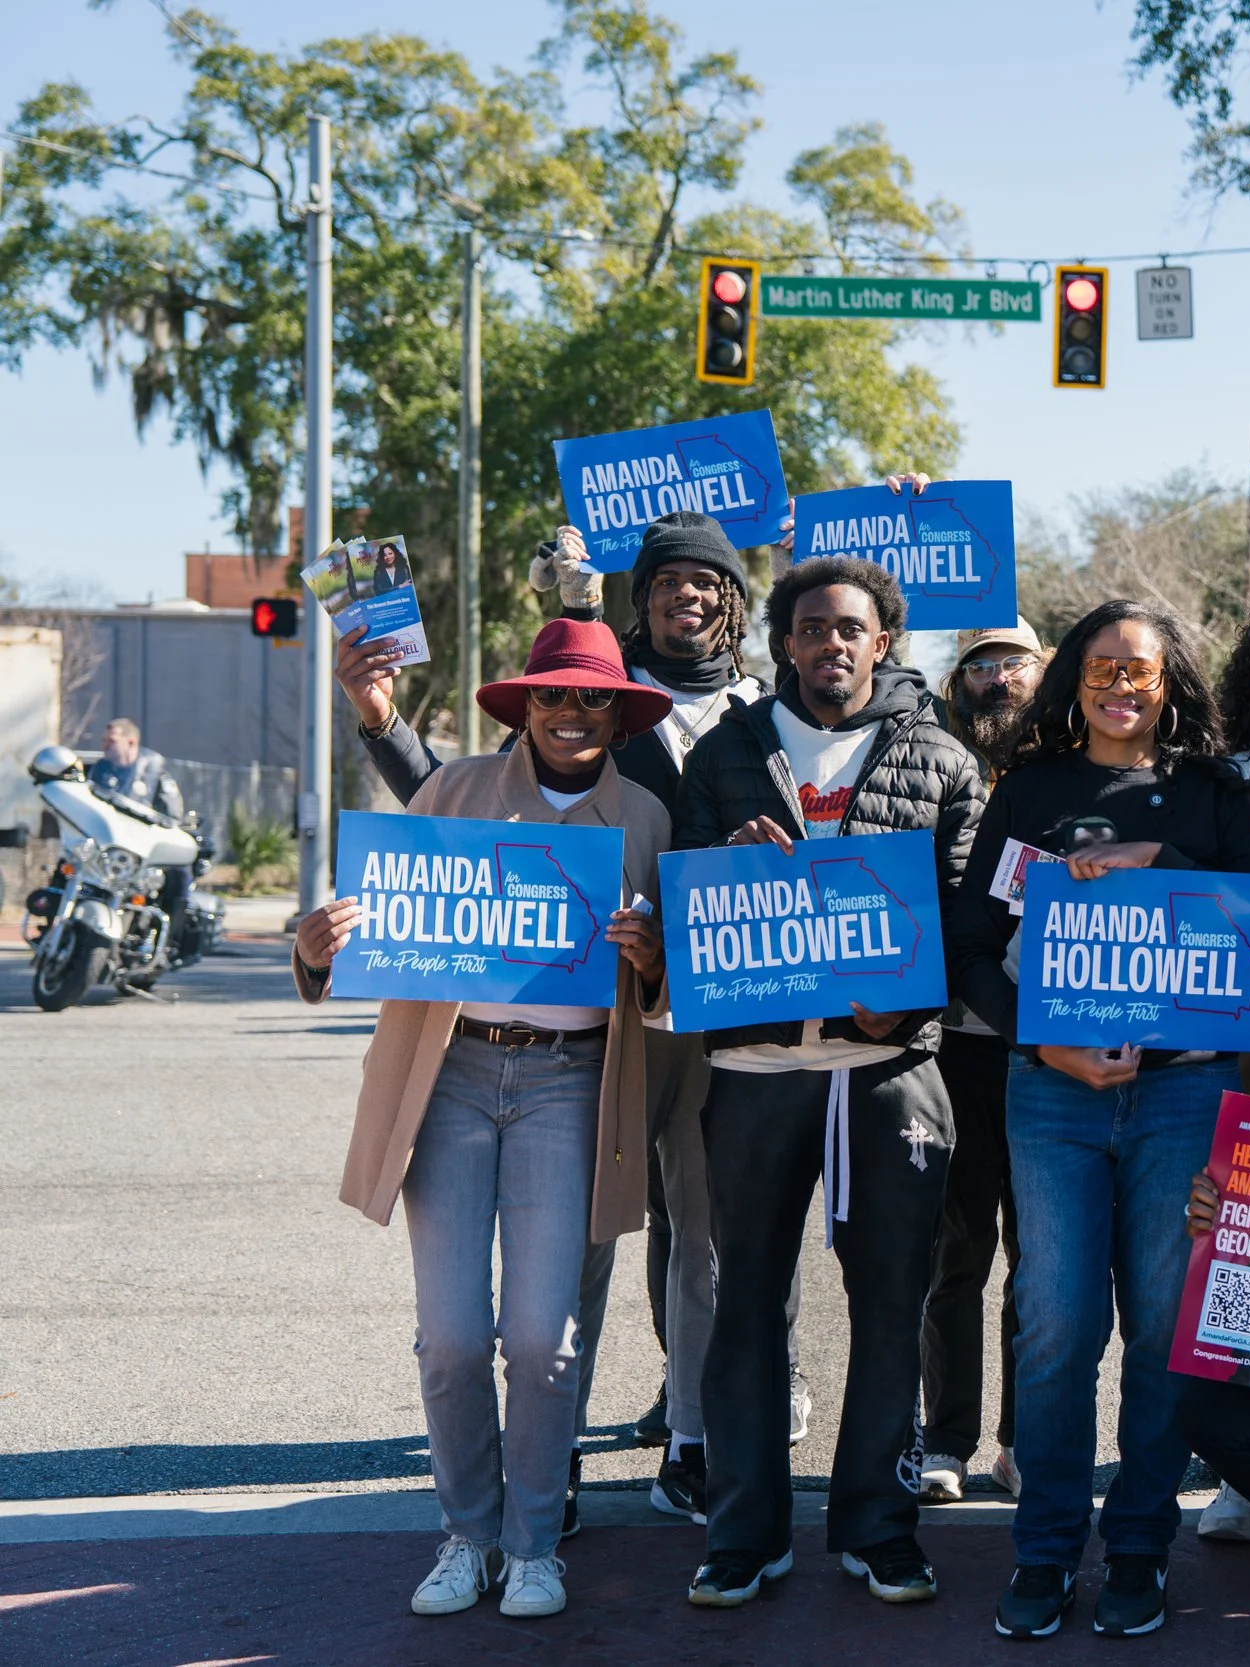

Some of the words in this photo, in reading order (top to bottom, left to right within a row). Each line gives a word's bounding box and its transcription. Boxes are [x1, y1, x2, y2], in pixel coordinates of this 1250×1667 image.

[1150, 273, 1178, 289] NO
[768, 284, 832, 308] Martin
[838, 288, 902, 310] Luther
[911, 291, 955, 314] King
[961, 294, 982, 312] Jr
[990, 293, 1034, 314] Blvd
[1148, 291, 1182, 305] TURN
[1154, 306, 1176, 320] ON
[1152, 321, 1179, 335] RED
[581, 453, 683, 496] AMANDA
[689, 459, 701, 474] for
[693, 460, 740, 478] CONGRESS
[585, 472, 755, 532] HOLLOWELL
[810, 513, 911, 553] AMANDA
[918, 521, 931, 537] for
[921, 530, 972, 543] CONGRESS
[593, 537, 620, 555] The
[361, 851, 493, 897] AMANDA
[505, 871, 519, 886] for
[507, 883, 568, 900] CONGRESS
[824, 887, 838, 902] for
[687, 878, 815, 926] AMANDA
[827, 894, 887, 912] CONGRESS
[360, 891, 576, 949] HOLLOWELL
[1043, 901, 1168, 944] AMANDA
[1178, 919, 1192, 935] for
[690, 911, 901, 974] HOLLOWELL
[1180, 931, 1238, 948] CONGRESS
[359, 949, 392, 970] The
[393, 950, 449, 976] People
[451, 954, 500, 975] First
[1042, 943, 1242, 997] HOLLOWELL
[694, 981, 726, 1004] The
[729, 978, 781, 1002] People
[783, 973, 828, 996] First
[1042, 998, 1073, 1021] The
[1073, 999, 1124, 1024] People
[1127, 1003, 1170, 1023] First
[1193, 1348, 1244, 1365] Congressional
